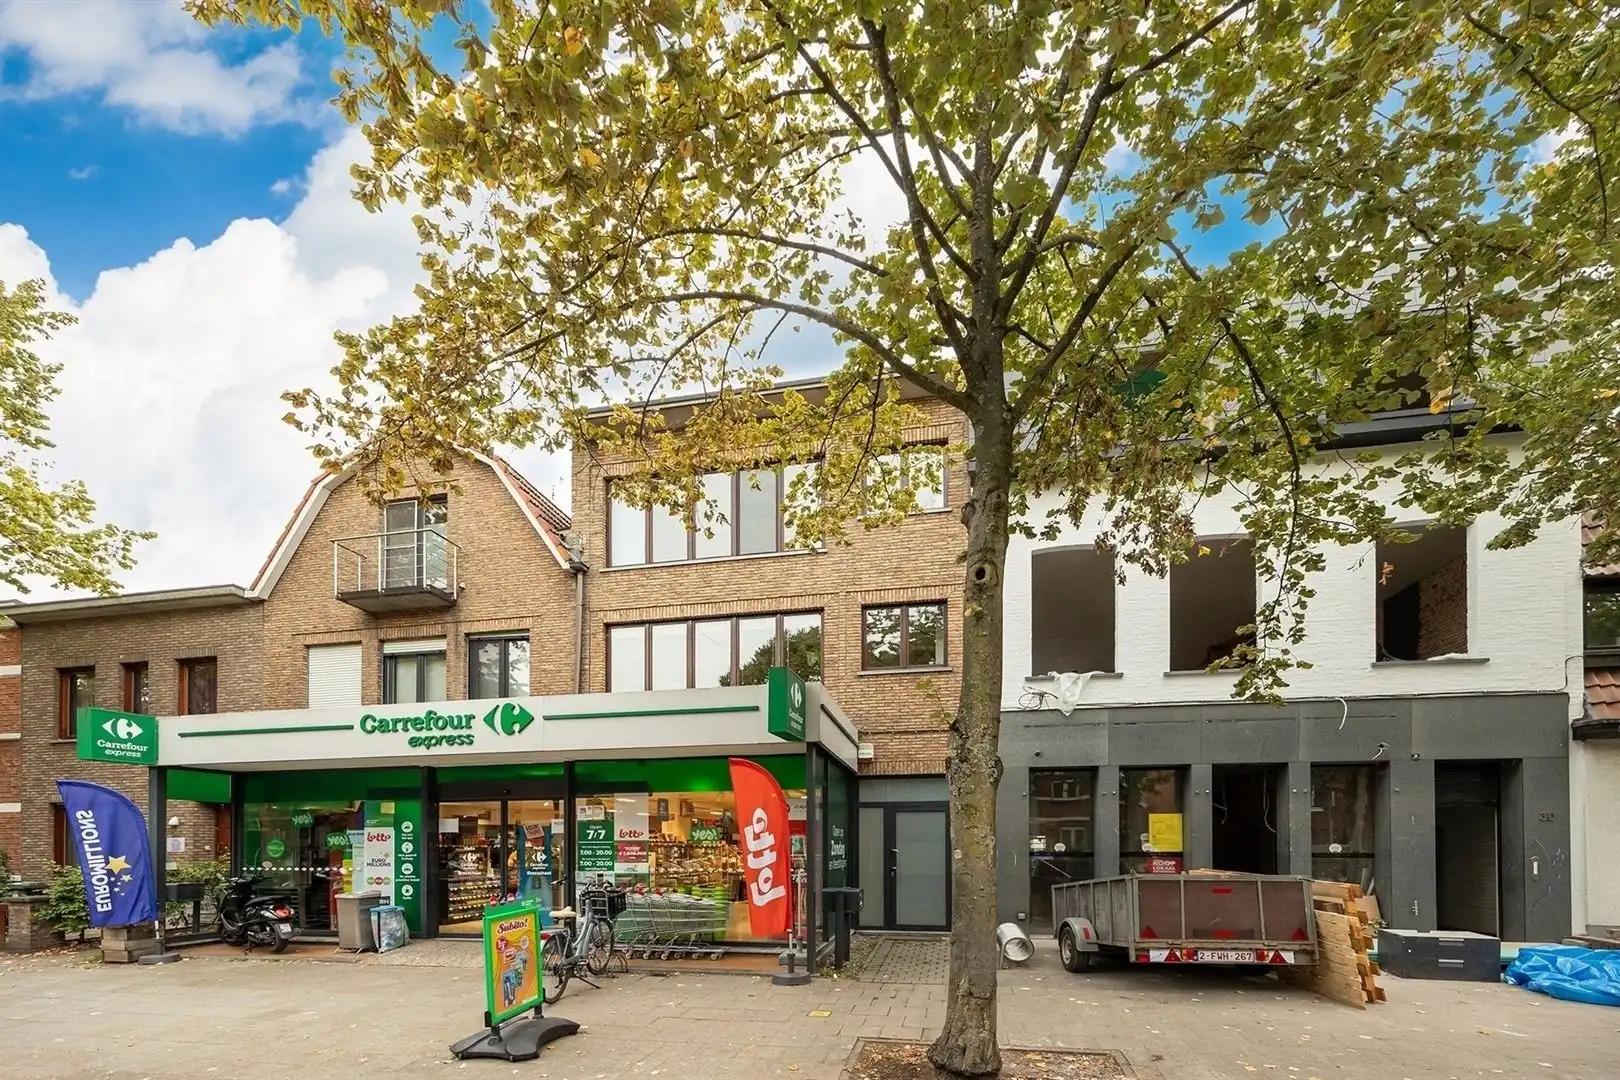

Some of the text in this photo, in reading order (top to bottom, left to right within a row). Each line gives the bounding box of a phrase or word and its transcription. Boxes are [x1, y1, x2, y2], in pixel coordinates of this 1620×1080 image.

[360, 709, 476, 734] Carrefour
[97, 739, 148, 752] Carrefour
[408, 733, 475, 750] express
[104, 749, 142, 758] express
[586, 829, 606, 840] 7/7
[692, 829, 717, 841] yes!
[497, 918, 528, 934] Subito!
[1199, 951, 1252, 961] 2-FWH-267
